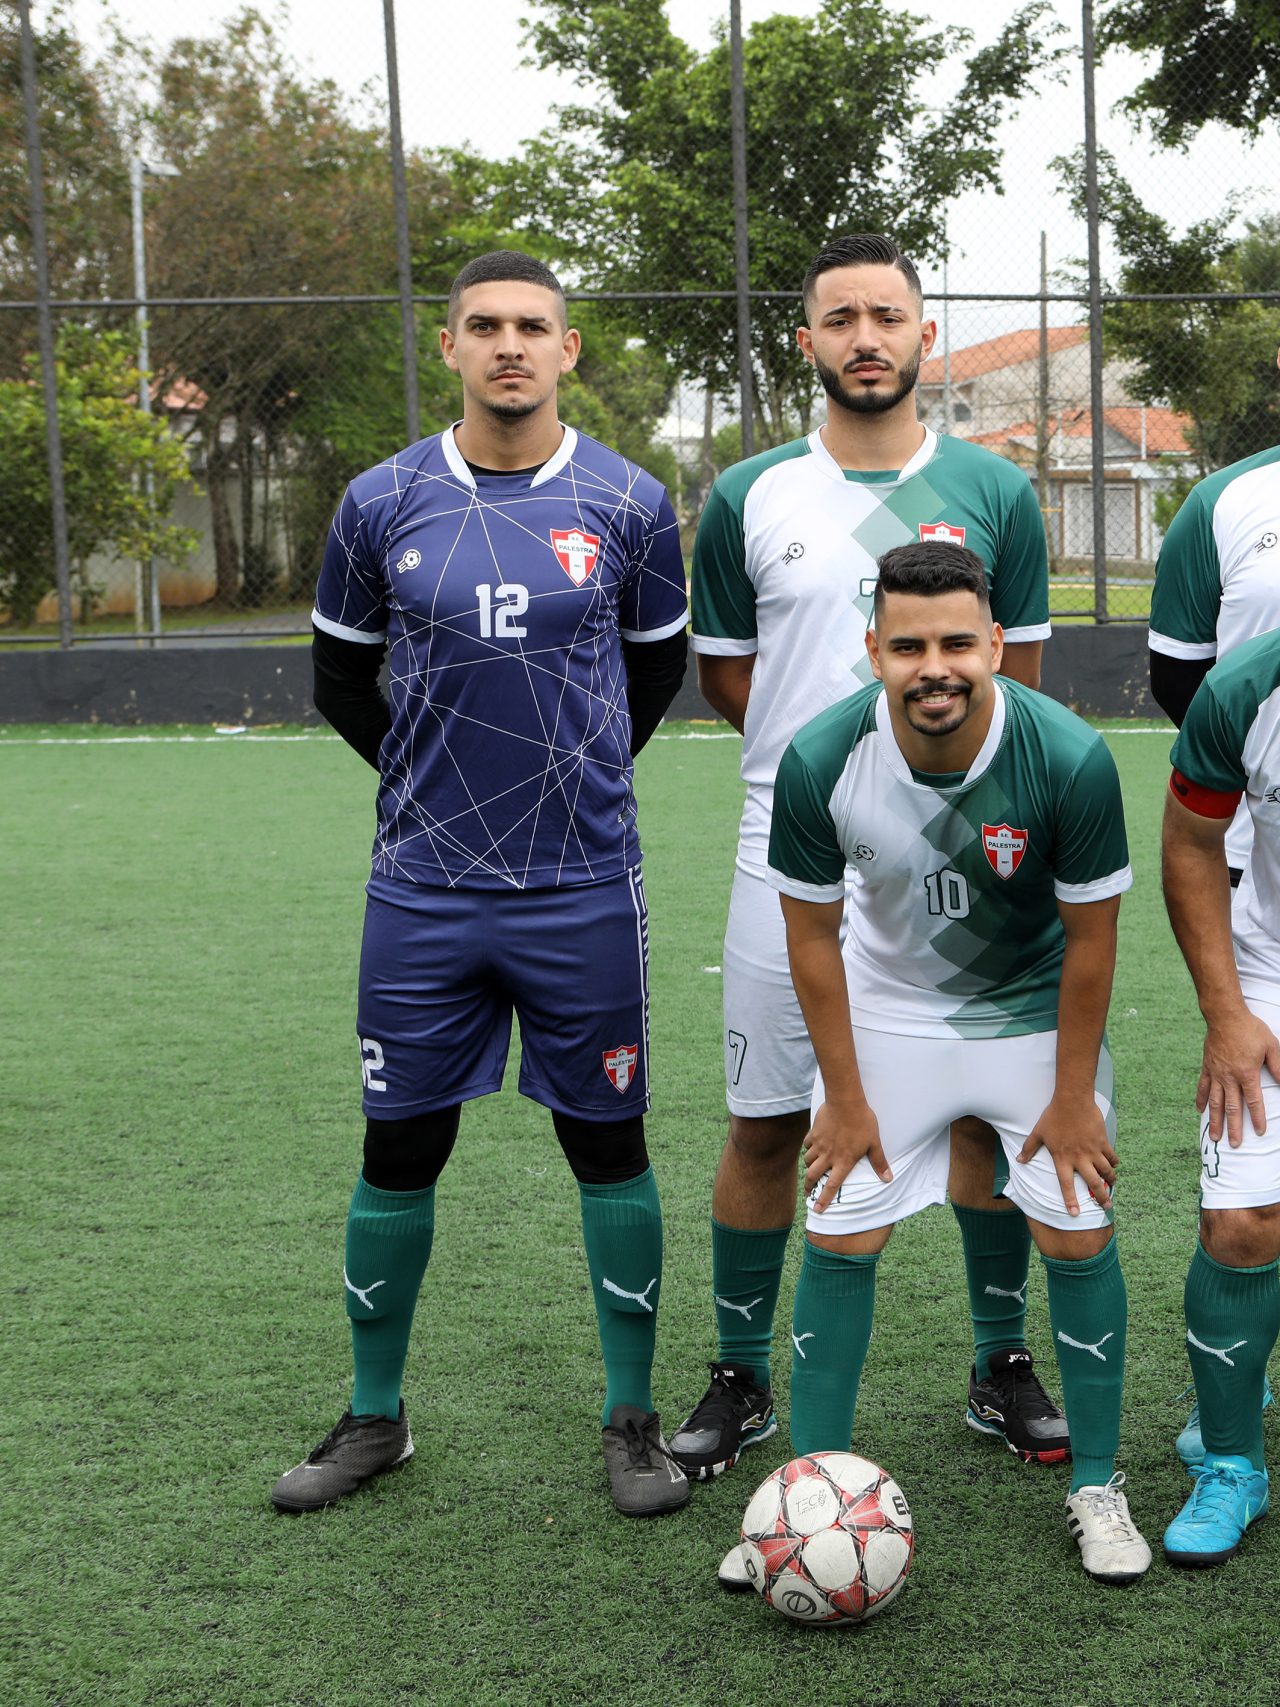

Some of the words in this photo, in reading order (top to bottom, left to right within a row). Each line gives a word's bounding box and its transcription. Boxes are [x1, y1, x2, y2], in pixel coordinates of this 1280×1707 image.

[558, 545, 594, 554] PALESTRA
[475, 584, 529, 638] 12
[988, 841, 1022, 850] PALESTRA
[924, 867, 970, 920] 10
[728, 1030, 747, 1085] 7
